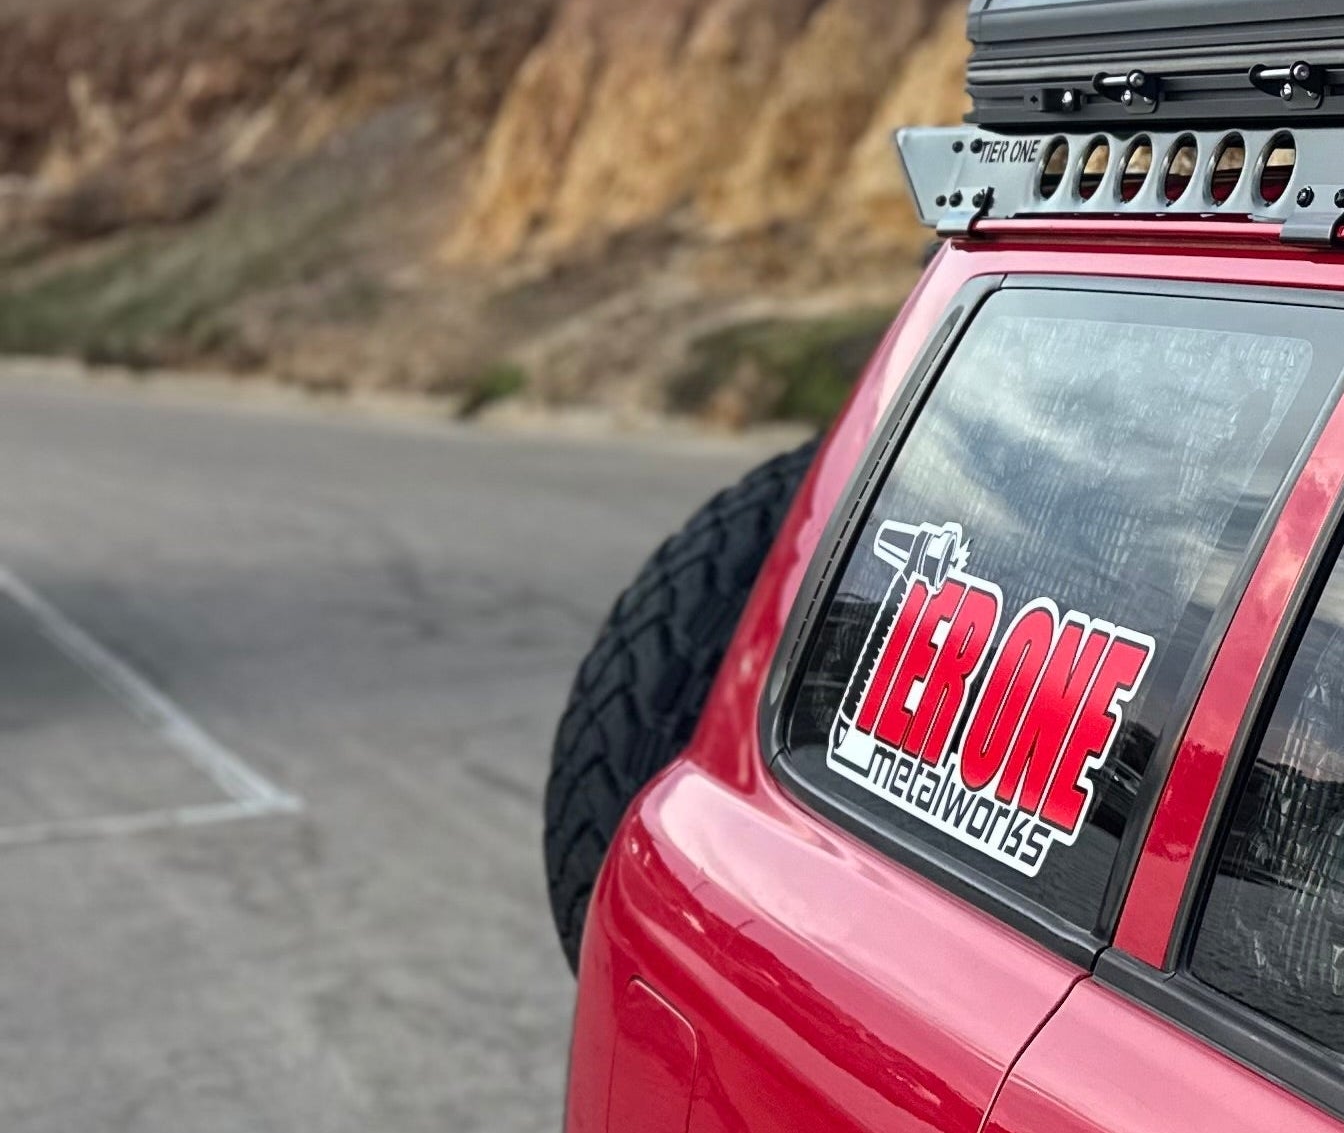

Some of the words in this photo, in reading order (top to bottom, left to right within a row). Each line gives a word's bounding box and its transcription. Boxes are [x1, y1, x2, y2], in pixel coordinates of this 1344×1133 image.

[980, 140, 1010, 163] TIER
[1010, 139, 1041, 163] ONE
[960, 607, 1150, 836] ONE
[866, 744, 1052, 867] metalworks
